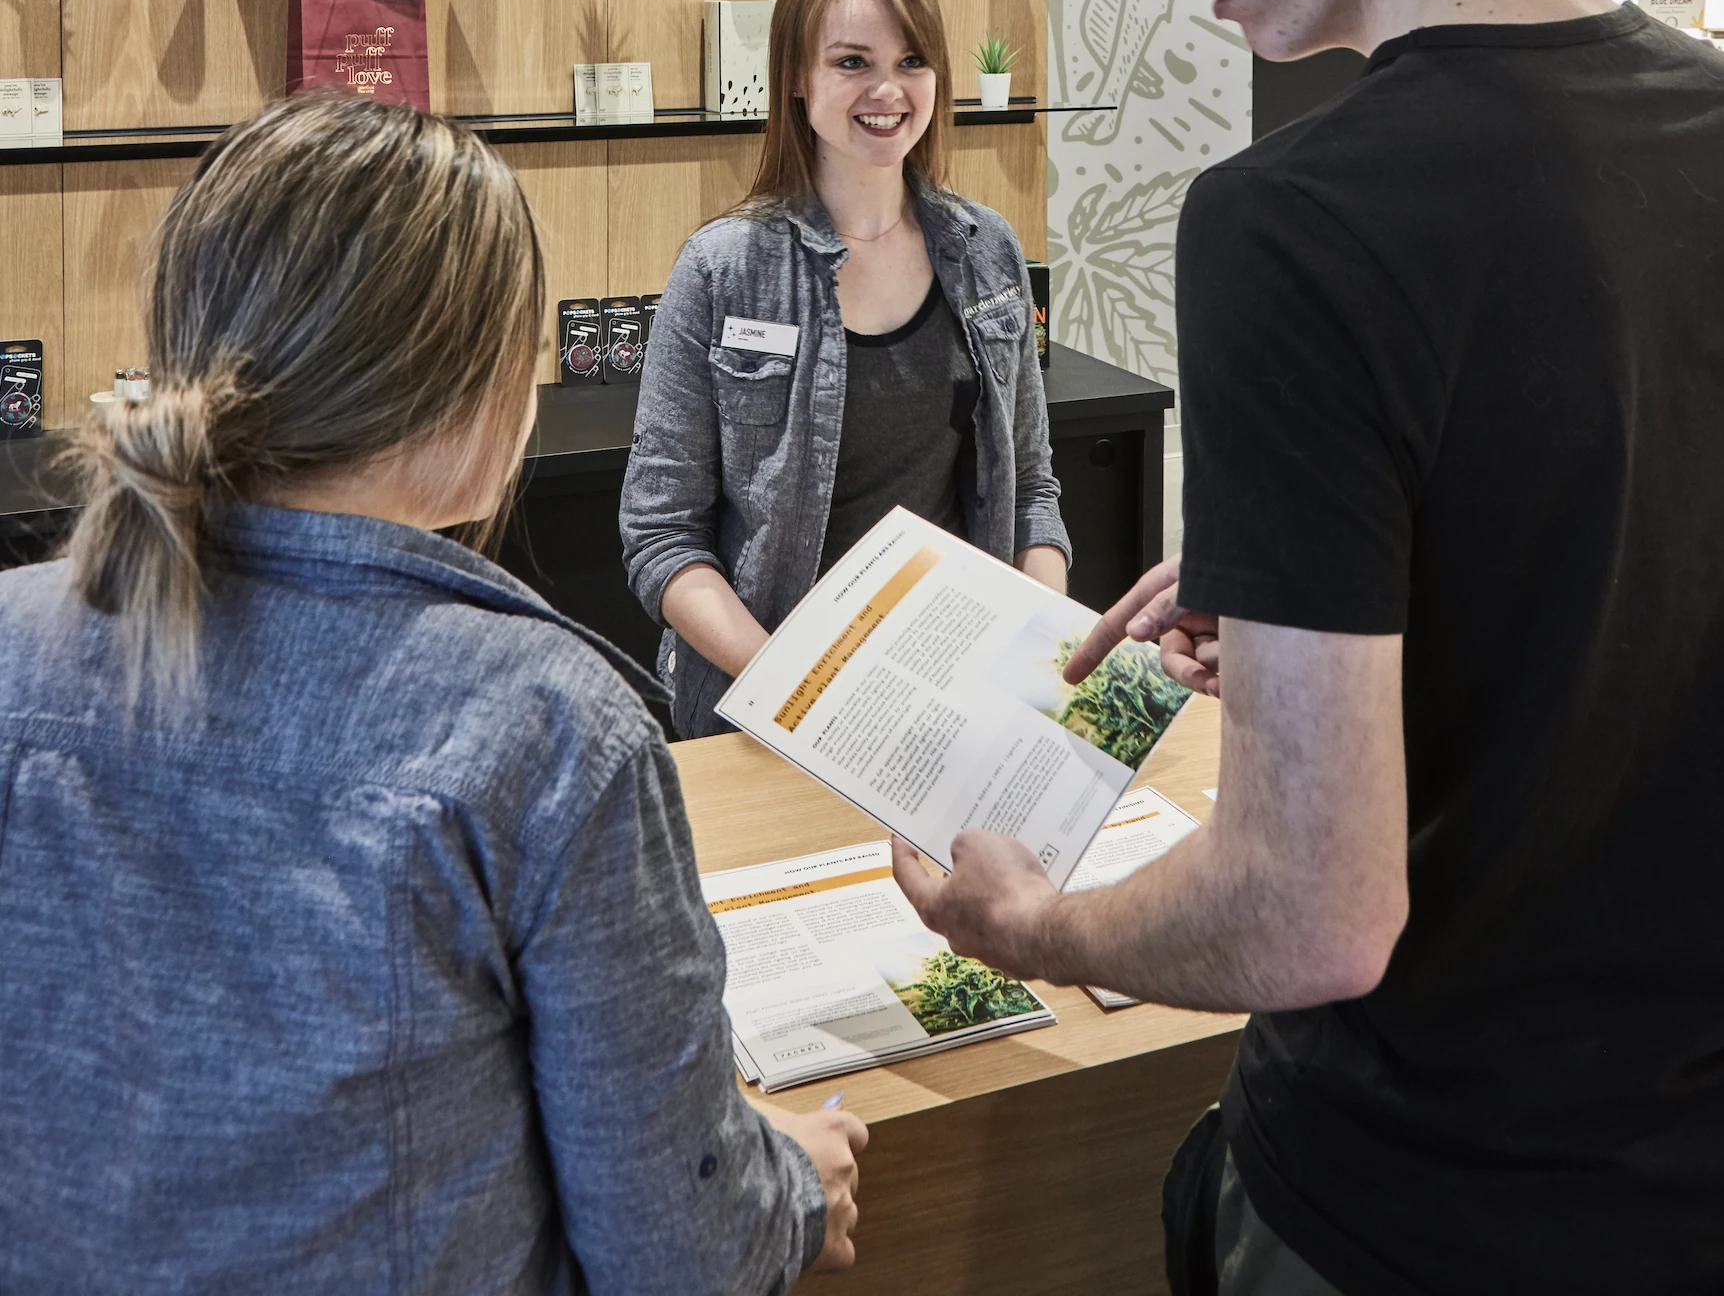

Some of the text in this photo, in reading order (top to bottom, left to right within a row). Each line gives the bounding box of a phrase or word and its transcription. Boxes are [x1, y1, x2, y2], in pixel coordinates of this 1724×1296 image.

[345, 27, 394, 53] puff
[336, 47, 386, 72] puff
[347, 66, 392, 84] love
[739, 328, 766, 338] JASMINE
[833, 529, 906, 602] HOW OUR PLANTS ARE RAISED
[773, 604, 874, 724] Sunlight Enrichment and
[786, 696, 816, 733] Active
[815, 665, 840, 693] Plant
[821, 715, 837, 734] PLANTS
[977, 780, 993, 802] Sodium
[1003, 736, 1023, 762] Lighting
[819, 859, 843, 867] PLANTS
[730, 887, 787, 902] Enrichment
[724, 902, 752, 912] Plant
[780, 1045, 819, 1058] 7ACRES
